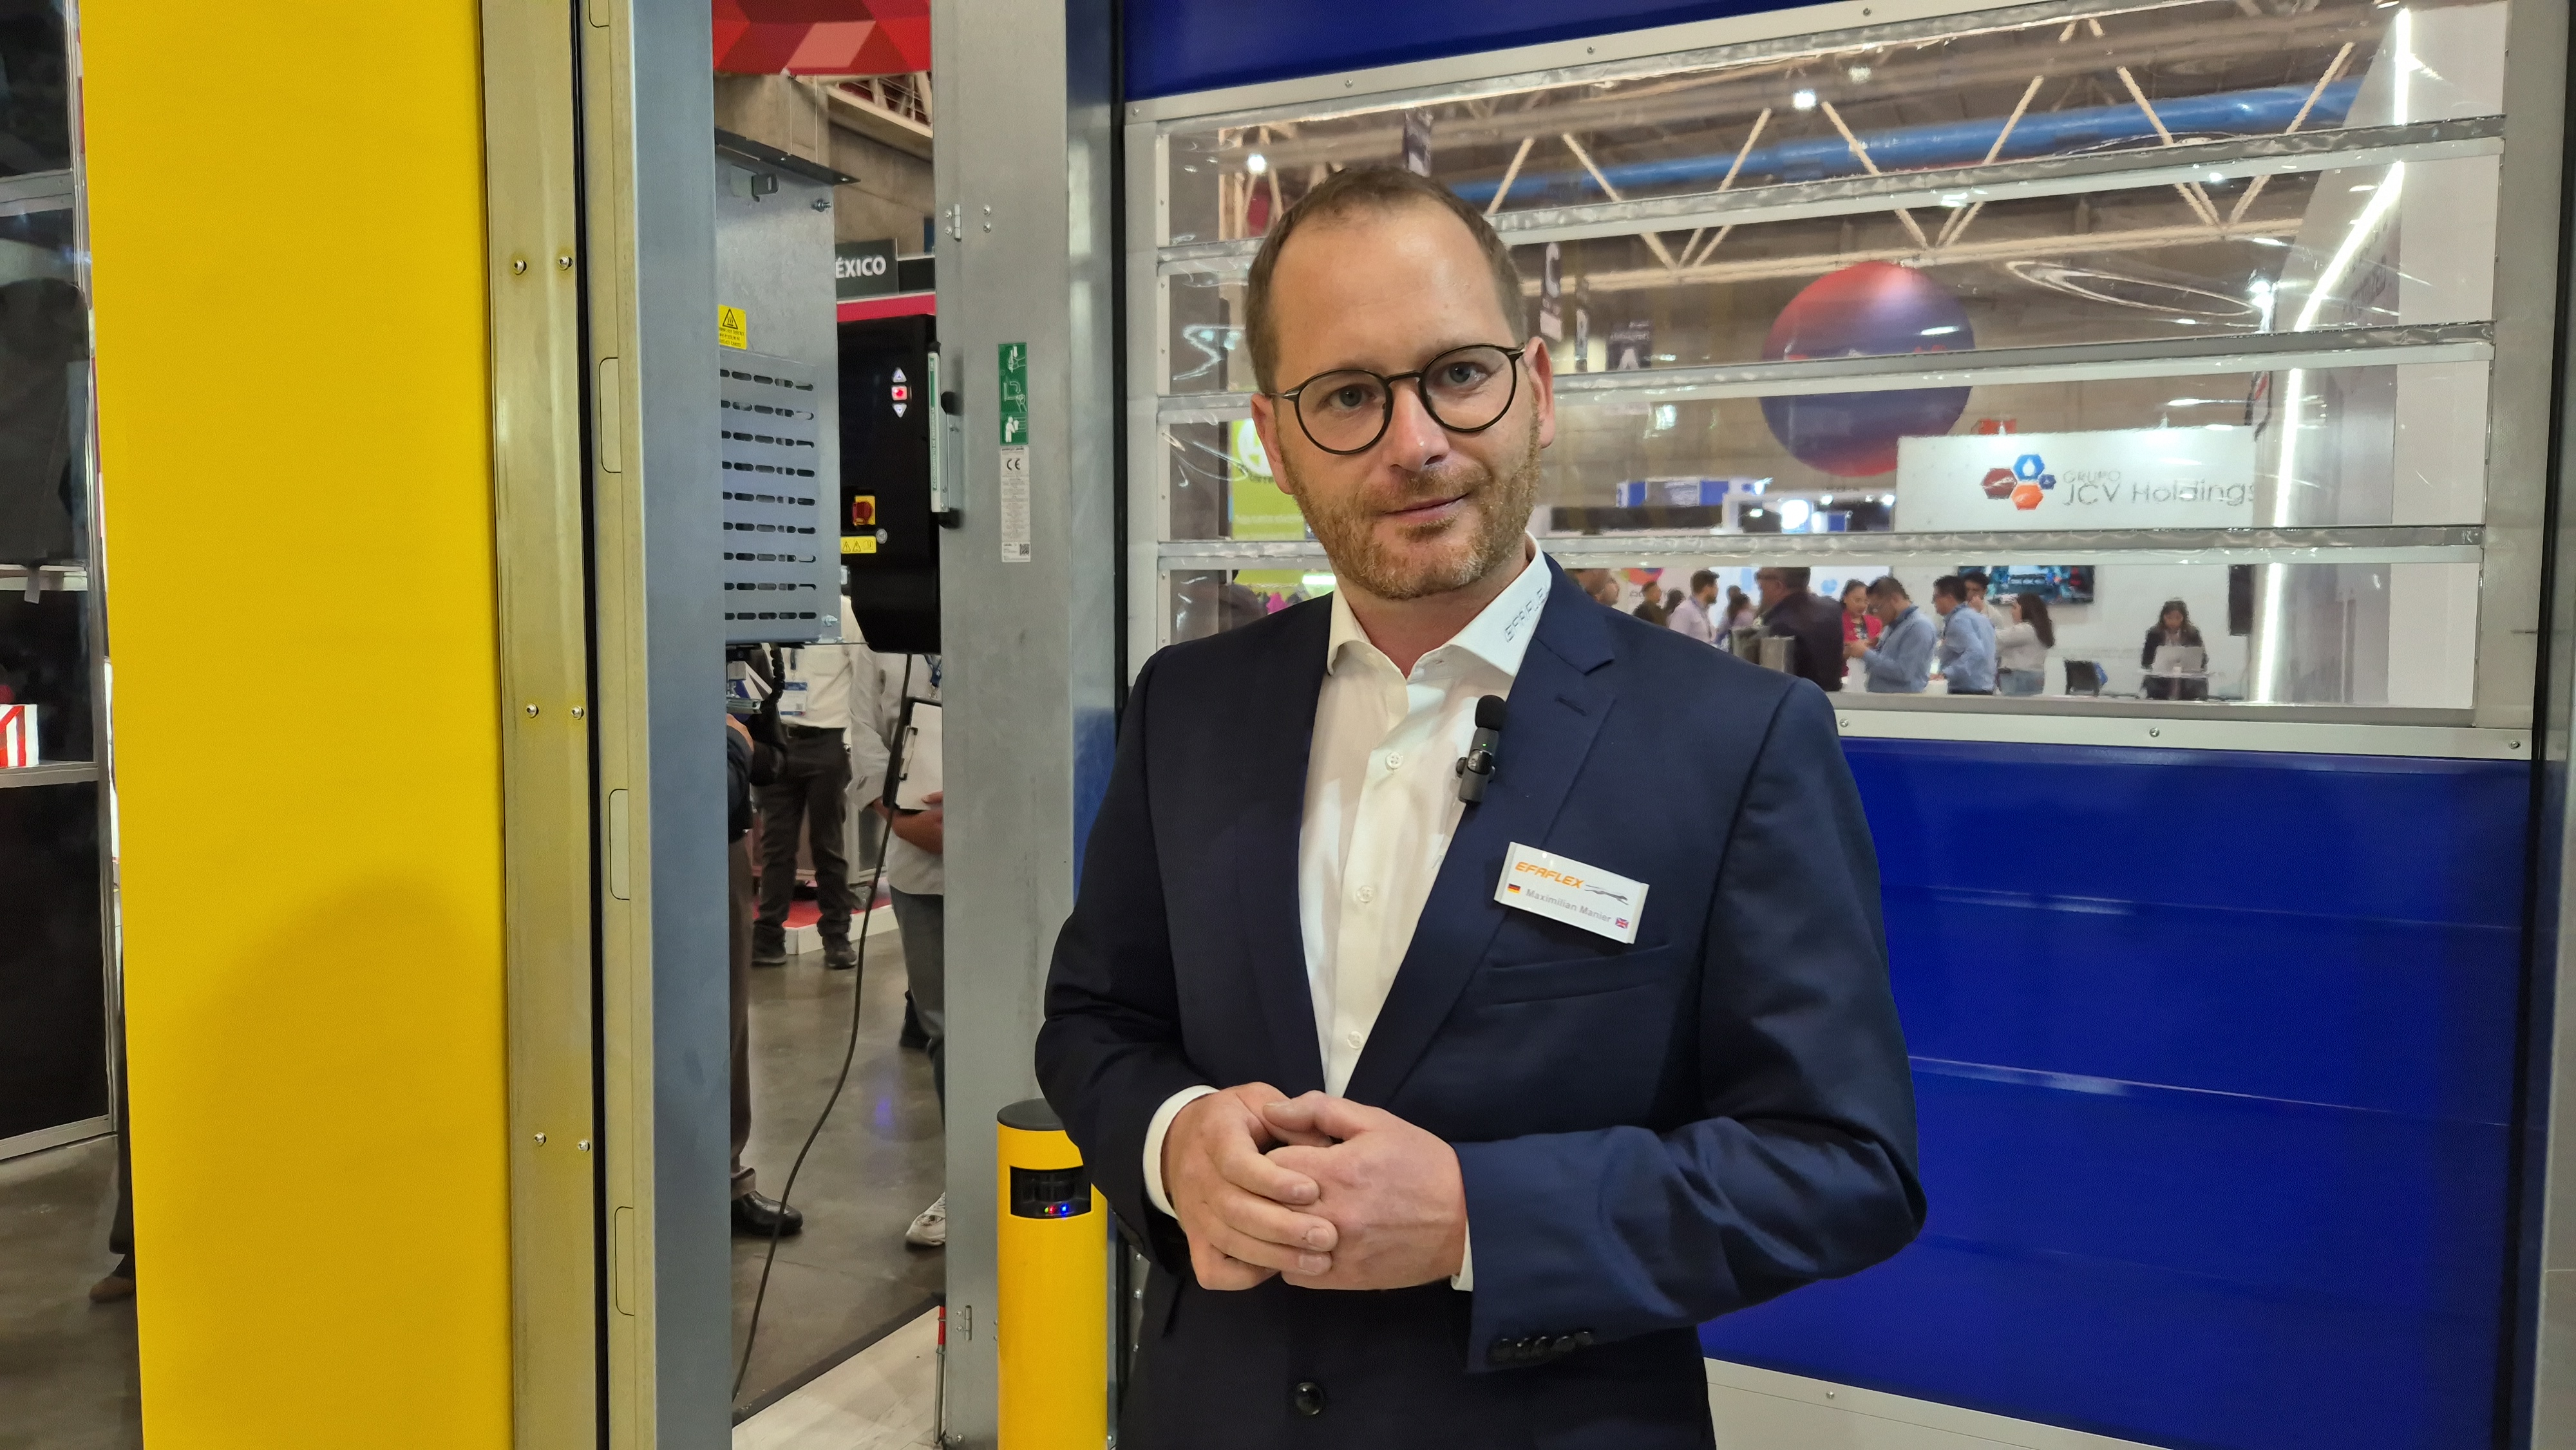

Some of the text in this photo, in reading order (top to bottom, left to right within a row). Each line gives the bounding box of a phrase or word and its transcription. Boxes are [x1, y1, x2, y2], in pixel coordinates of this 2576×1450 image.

[836, 255, 886, 278] ÉXICO
[2063, 484, 2120, 505] JCV
[1515, 862, 1584, 889] EFAFLEX
[1526, 889, 1611, 923] Maximilian Manier
